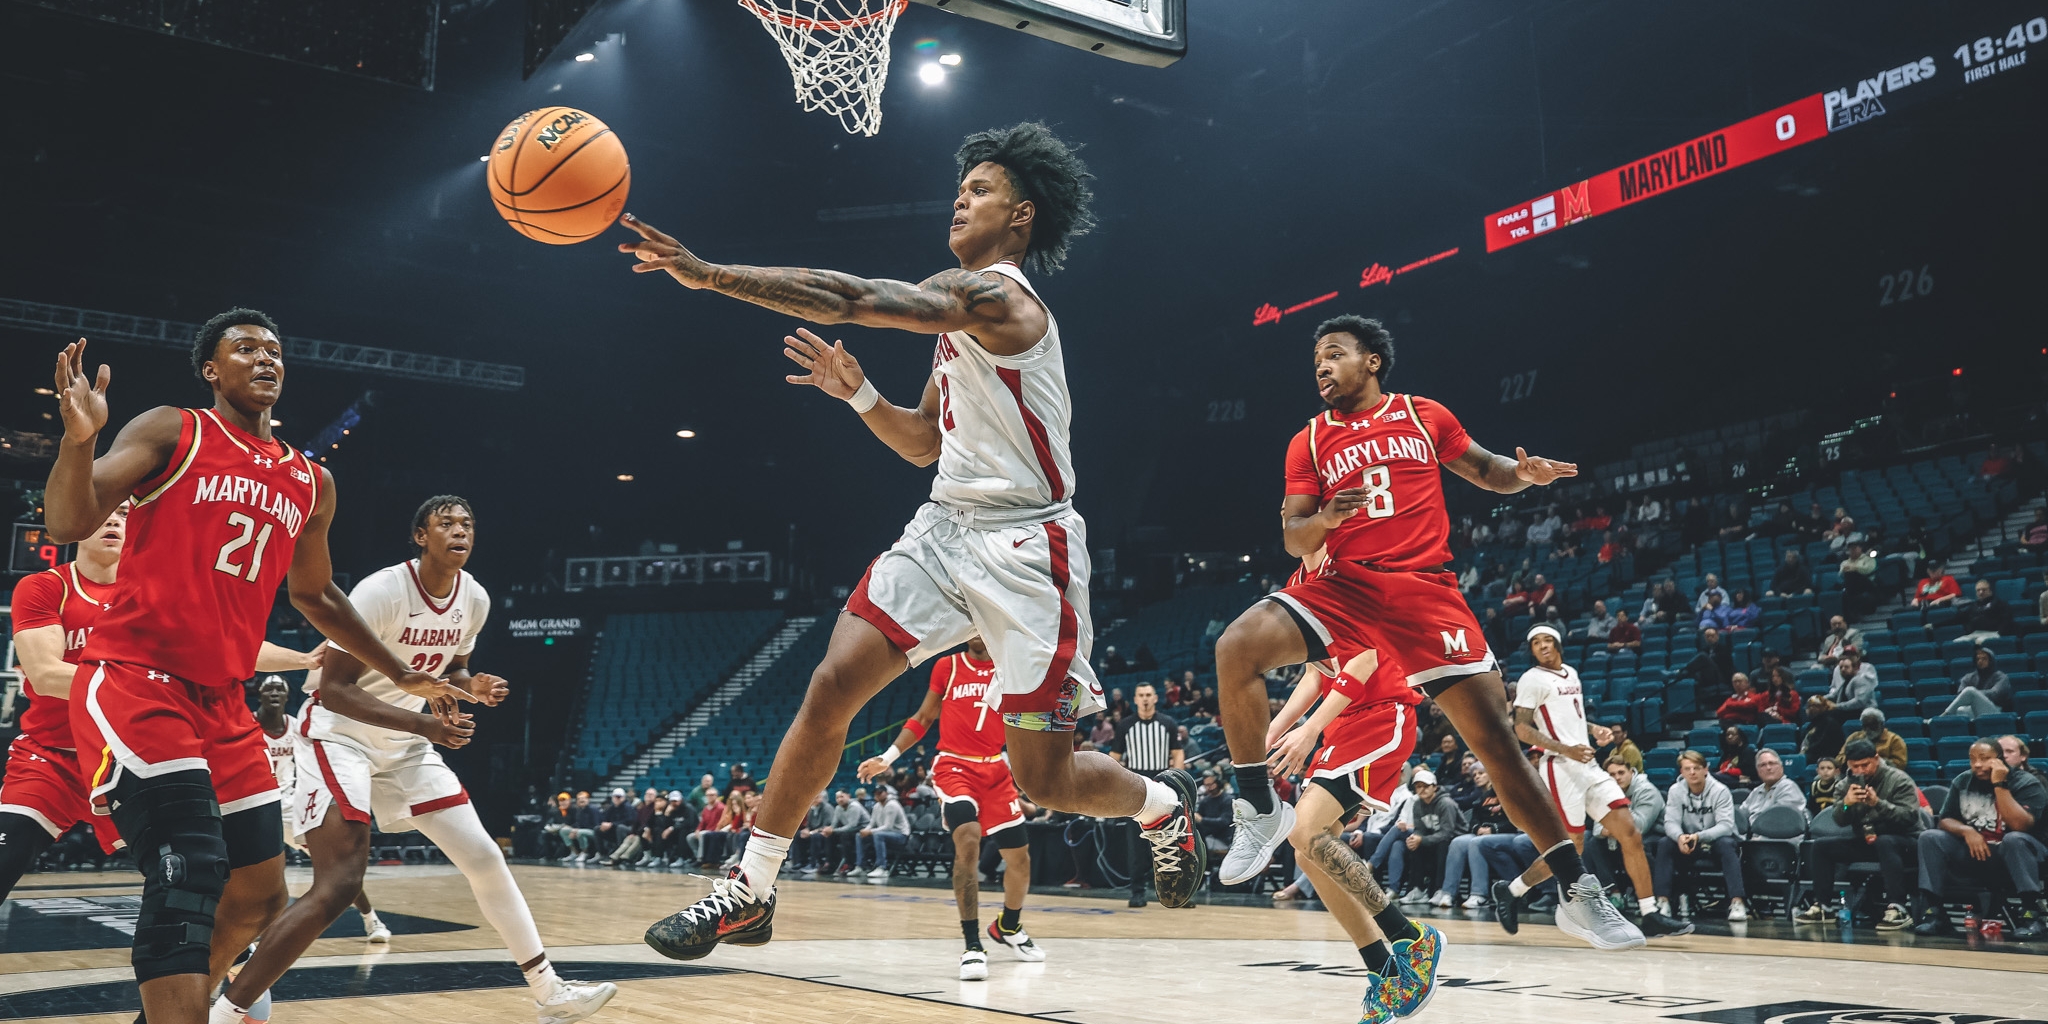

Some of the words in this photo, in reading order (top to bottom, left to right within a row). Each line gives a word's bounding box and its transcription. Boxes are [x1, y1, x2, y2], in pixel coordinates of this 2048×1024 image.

[1953, 16, 2048, 68] 18:40
[1823, 56, 1937, 111] PLAYERS
[1964, 62, 1996, 84] FIRST
[1999, 50, 2027, 72] HALF
[536, 111, 588, 150] NCAA
[1775, 114, 1796, 141] 0
[1828, 97, 1886, 133] ERA
[1618, 134, 1727, 202] MARYLAND
[1497, 208, 1528, 227] FOULS
[1561, 179, 1591, 222] M
[1540, 216, 1548, 227] 4
[1359, 262, 1394, 289] Lilly
[1880, 264, 1933, 307] 226
[1500, 369, 1537, 404] 227
[1321, 436, 1428, 488] MARYLAND
[1732, 464, 1745, 478] 26
[1825, 446, 1840, 461] 25
[192, 475, 302, 539] MARYLAND
[1362, 464, 1395, 519] 8
[214, 511, 274, 583] 21
[398, 626, 462, 647] ALABAMA
[508, 619, 538, 630] MGM
[539, 617, 581, 629] GRAND
[1440, 628, 1470, 655] M
[973, 701, 989, 732] 7
